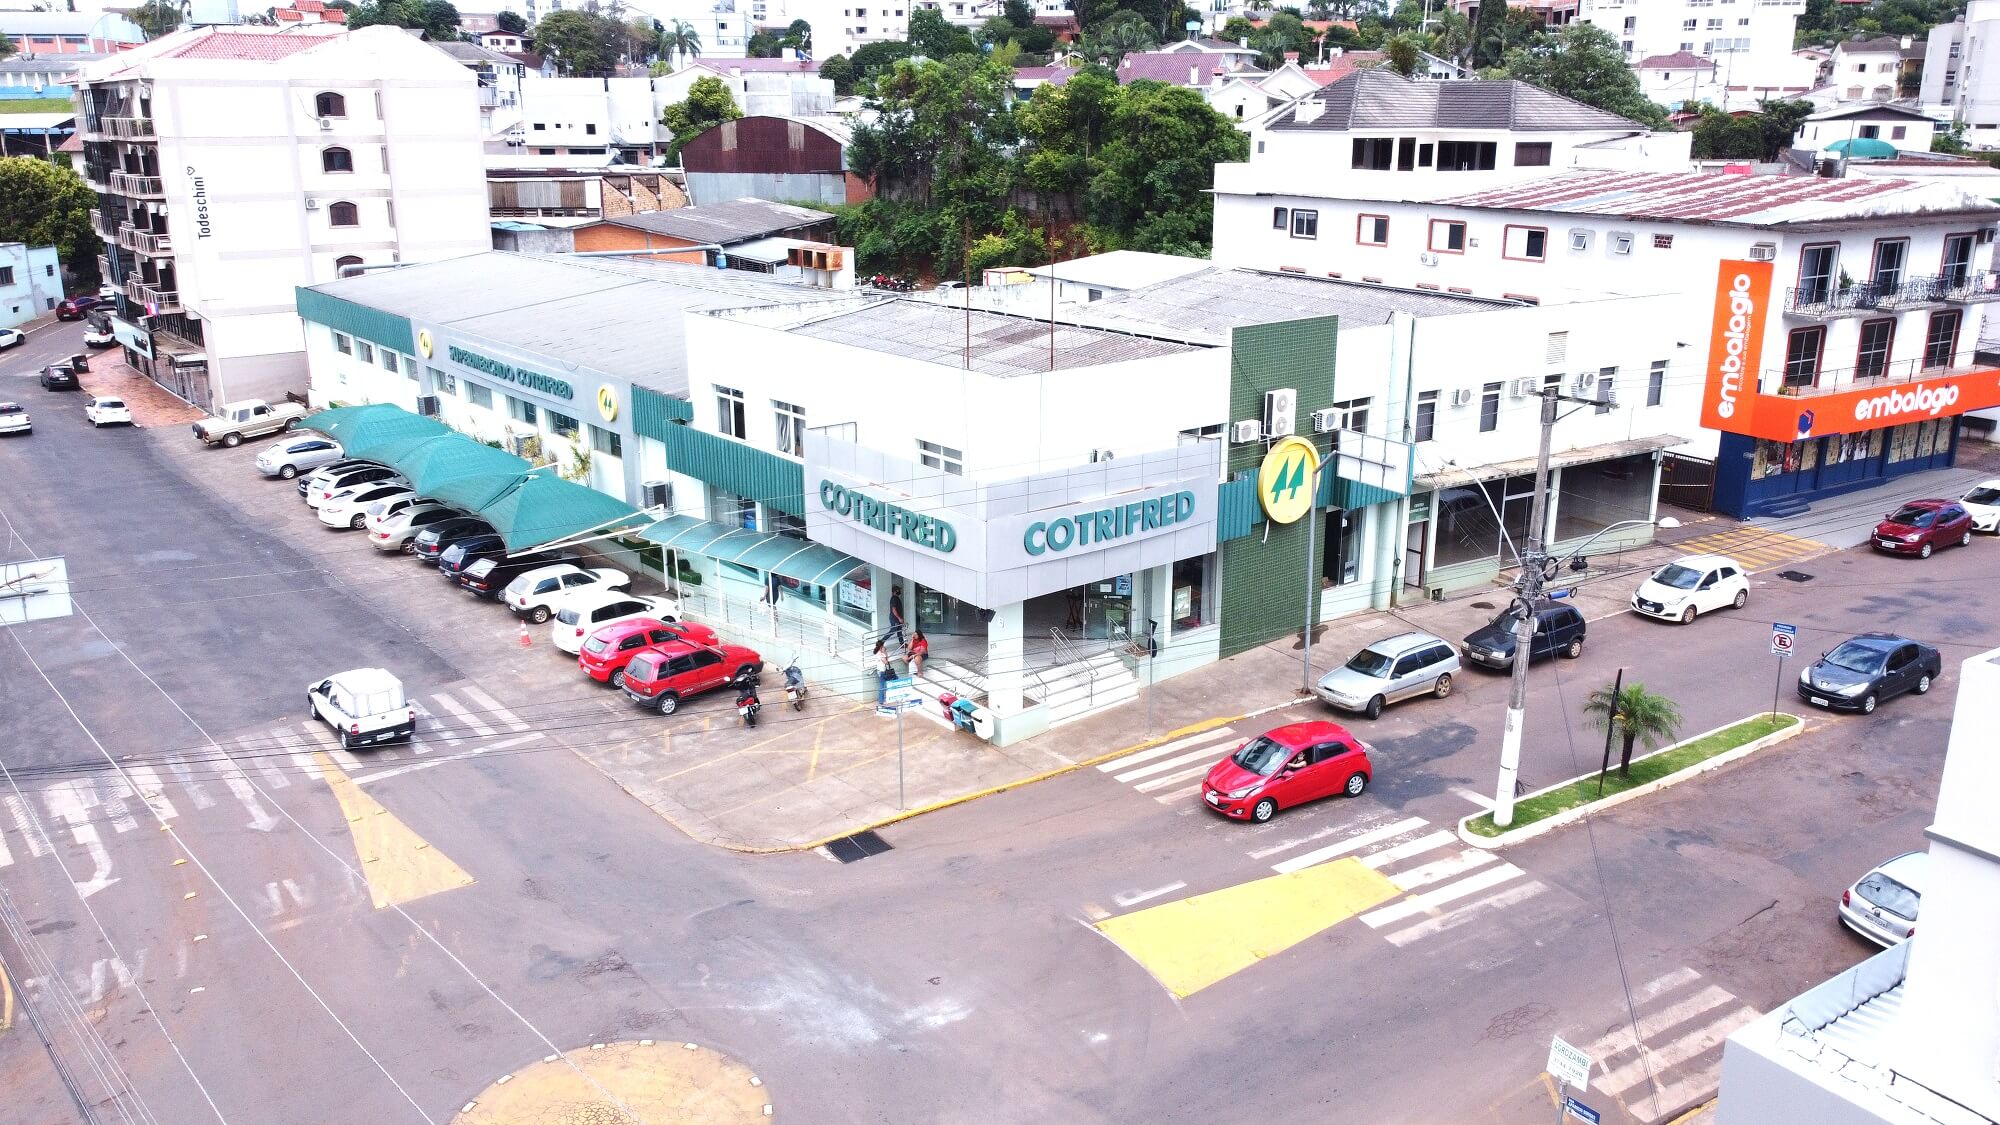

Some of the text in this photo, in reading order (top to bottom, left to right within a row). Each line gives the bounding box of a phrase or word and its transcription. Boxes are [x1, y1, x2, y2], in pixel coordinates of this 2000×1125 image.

[190, 176, 212, 240] Todeschini
[1717, 273, 1754, 419] embalagio
[1743, 314, 1752, 350] embalagem
[448, 344, 574, 400] SUPERMERCADO COTRIFRED
[1855, 383, 1960, 421] embalagio
[820, 478, 957, 553] COTRIFRED
[1023, 490, 1196, 557] COTRIFRED
[1554, 1042, 1589, 1068] AGROZAMBI
